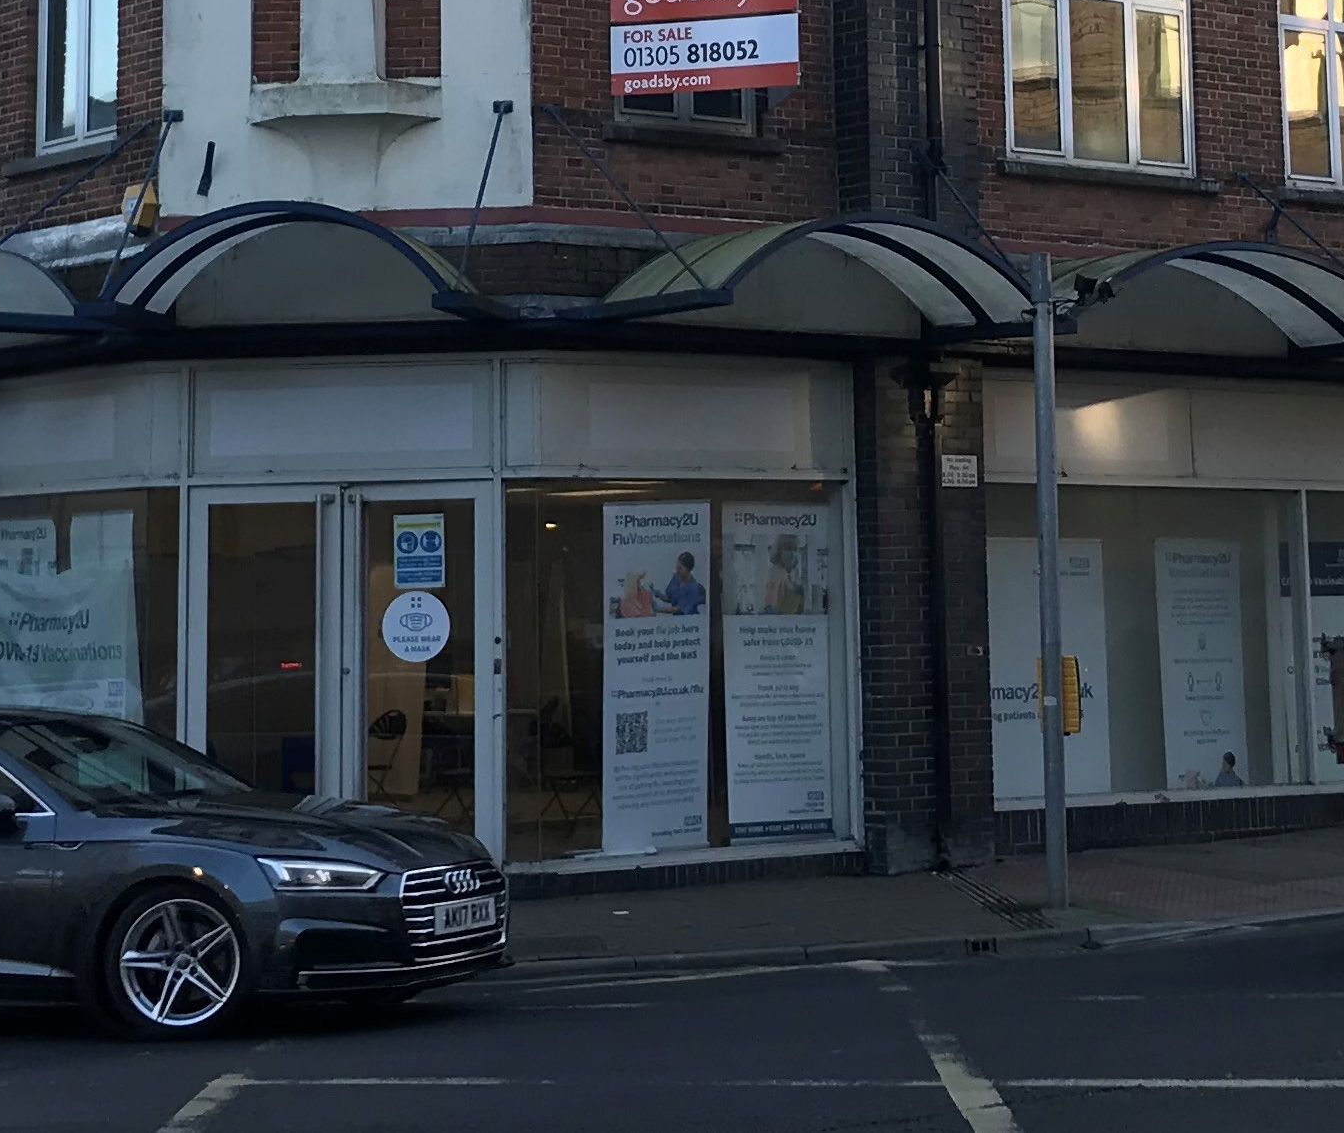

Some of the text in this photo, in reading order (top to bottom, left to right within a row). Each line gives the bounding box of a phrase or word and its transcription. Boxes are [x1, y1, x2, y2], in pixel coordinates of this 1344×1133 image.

[623, 26, 693, 44] FOR SALE
[623, 39, 759, 68] 01305 818052
[624, 74, 711, 93] goadsby.com
[624, 512, 699, 529] Pharmacy2U
[743, 512, 817, 529] Pharmacy2U
[392, 635, 418, 643] PLEASE
